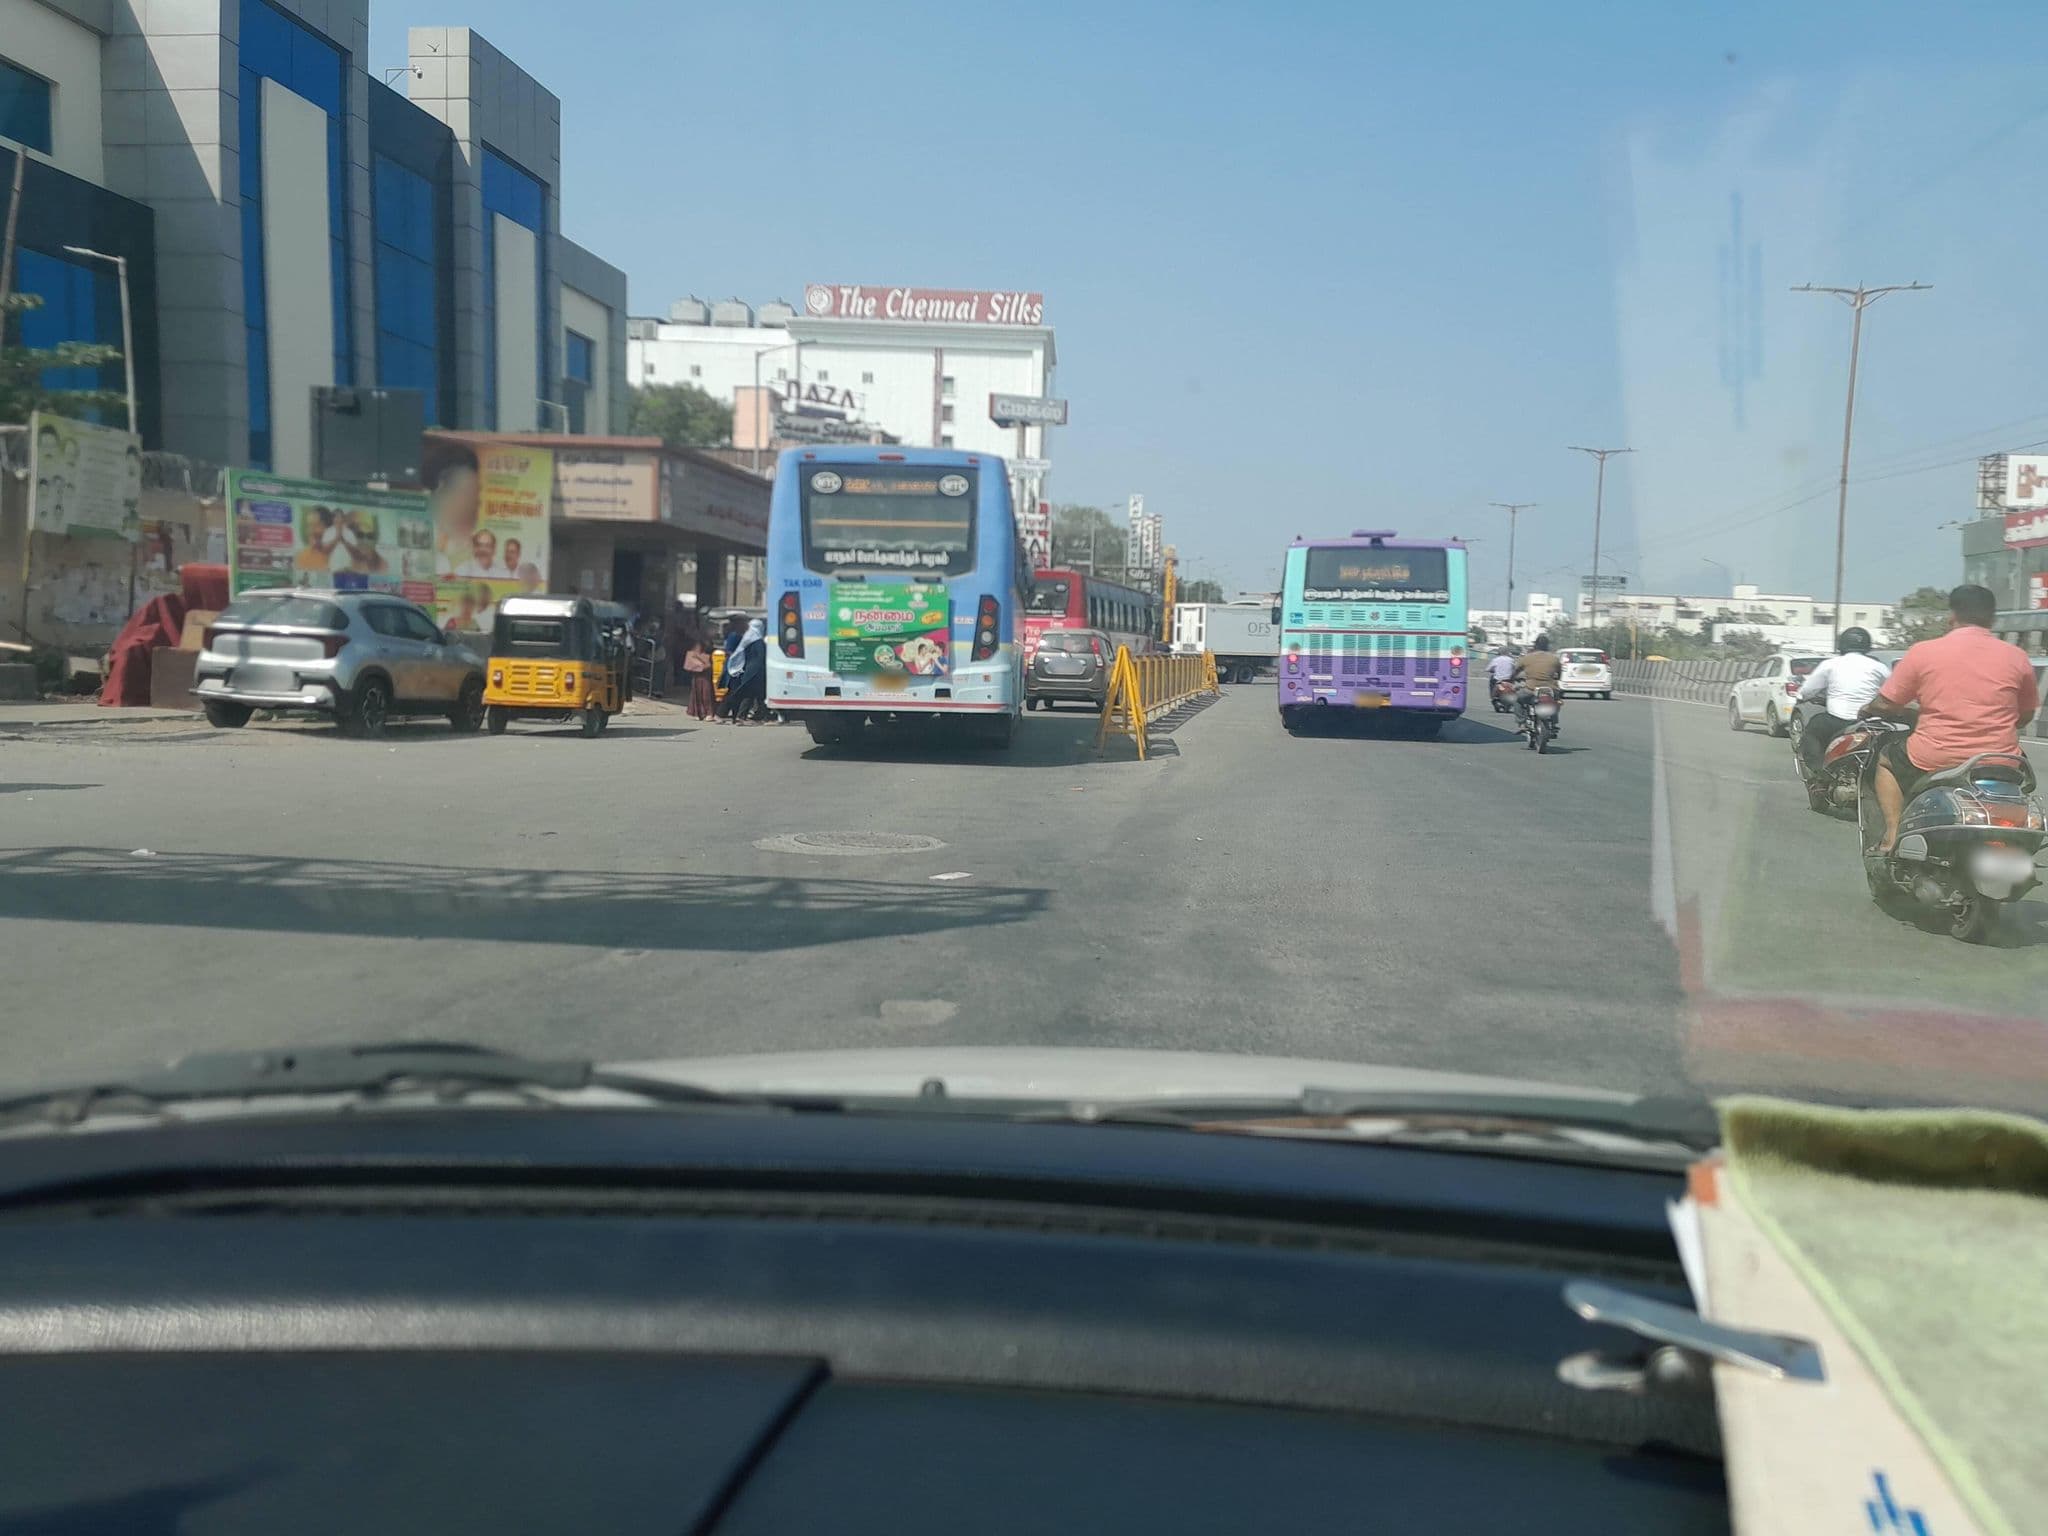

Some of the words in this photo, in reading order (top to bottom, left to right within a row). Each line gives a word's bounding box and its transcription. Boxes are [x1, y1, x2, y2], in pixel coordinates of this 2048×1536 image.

[839, 286, 875, 316] The
[885, 288, 977, 321] Chennai
[986, 292, 1042, 323] Silks
[1247, 621, 1271, 634] OFS
